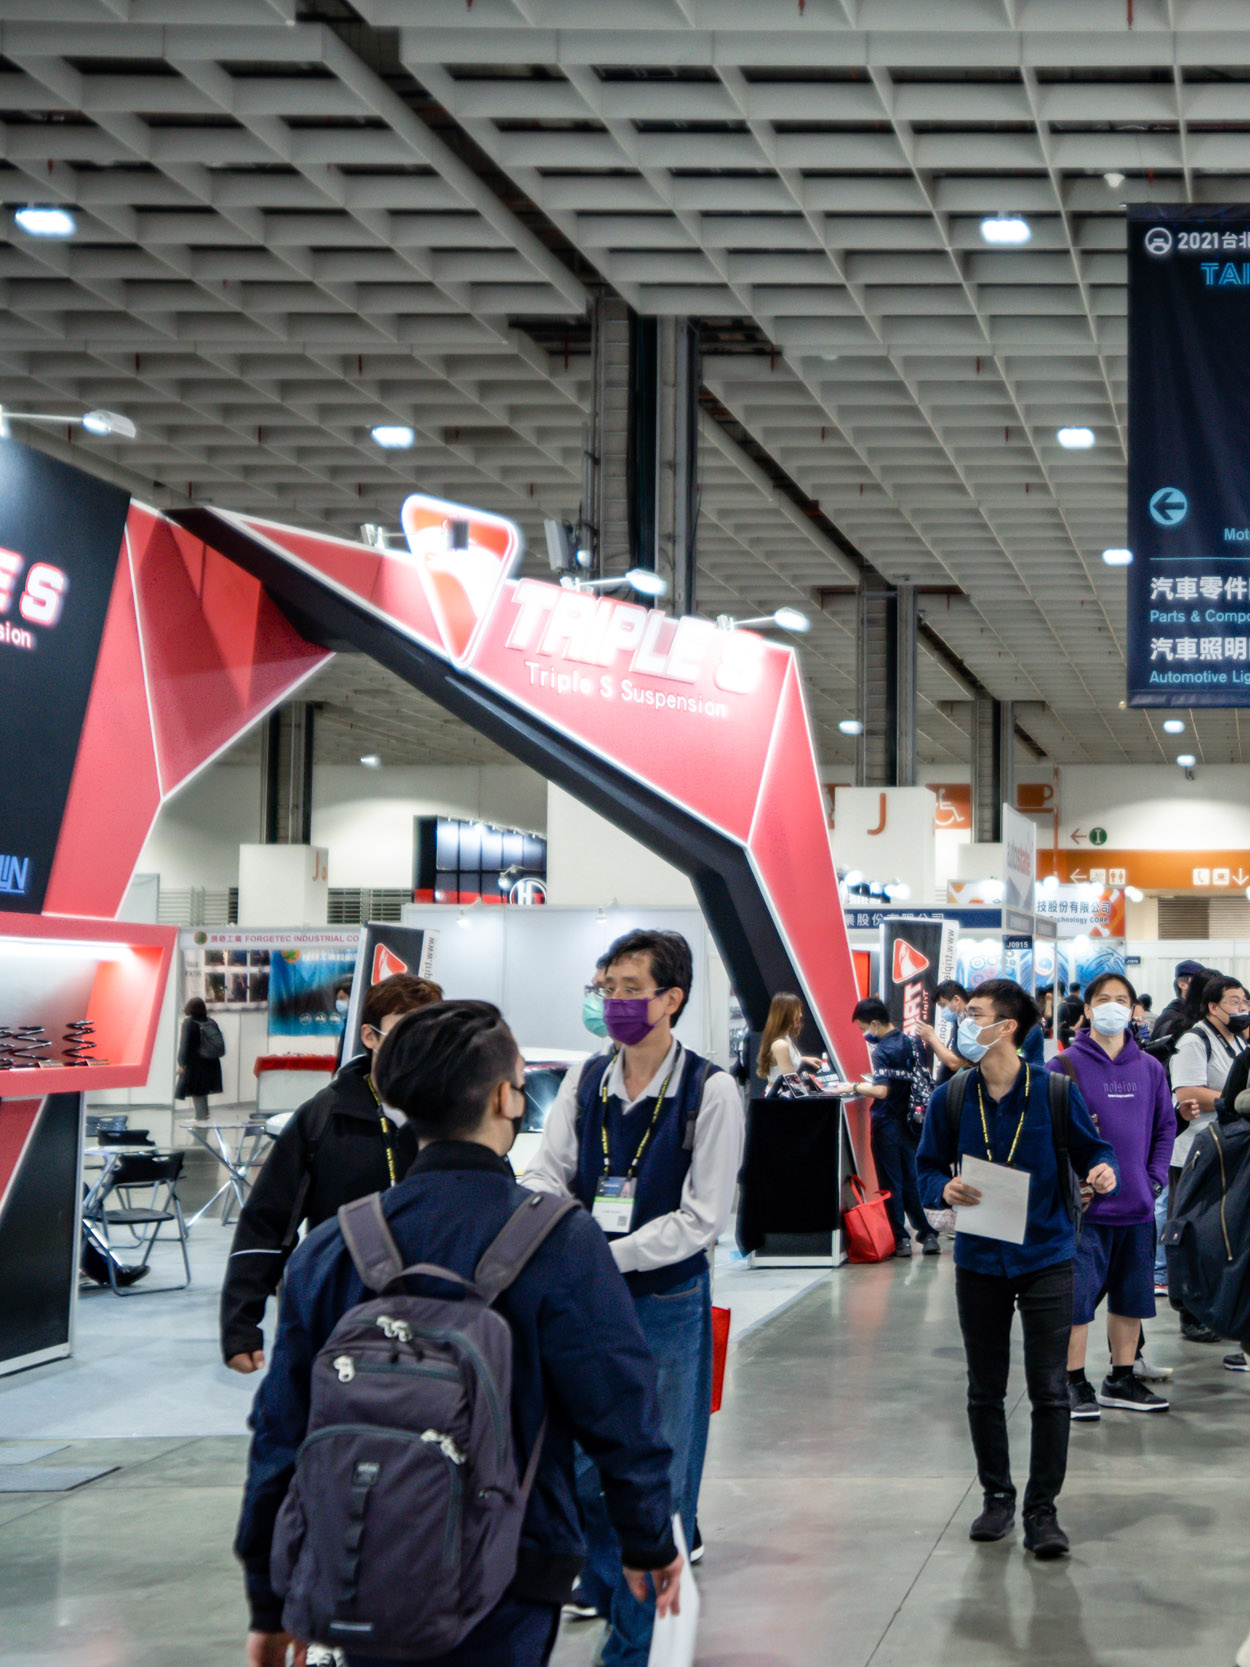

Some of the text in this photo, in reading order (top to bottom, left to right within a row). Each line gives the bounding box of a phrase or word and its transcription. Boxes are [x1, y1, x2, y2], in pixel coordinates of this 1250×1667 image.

[1150, 609, 1186, 623] Parts
[1190, 610, 1201, 622] &
[0, 619, 32, 649] sion
[505, 577, 714, 685] TRIPLE
[1149, 670, 1227, 683] Automotive
[525, 660, 728, 718] Triple S Suspension
[866, 792, 886, 836] J
[245, 935, 291, 943] FORGETEC
[294, 934, 344, 942] INDUSTRIAL
[1006, 941, 1029, 949] J0915
